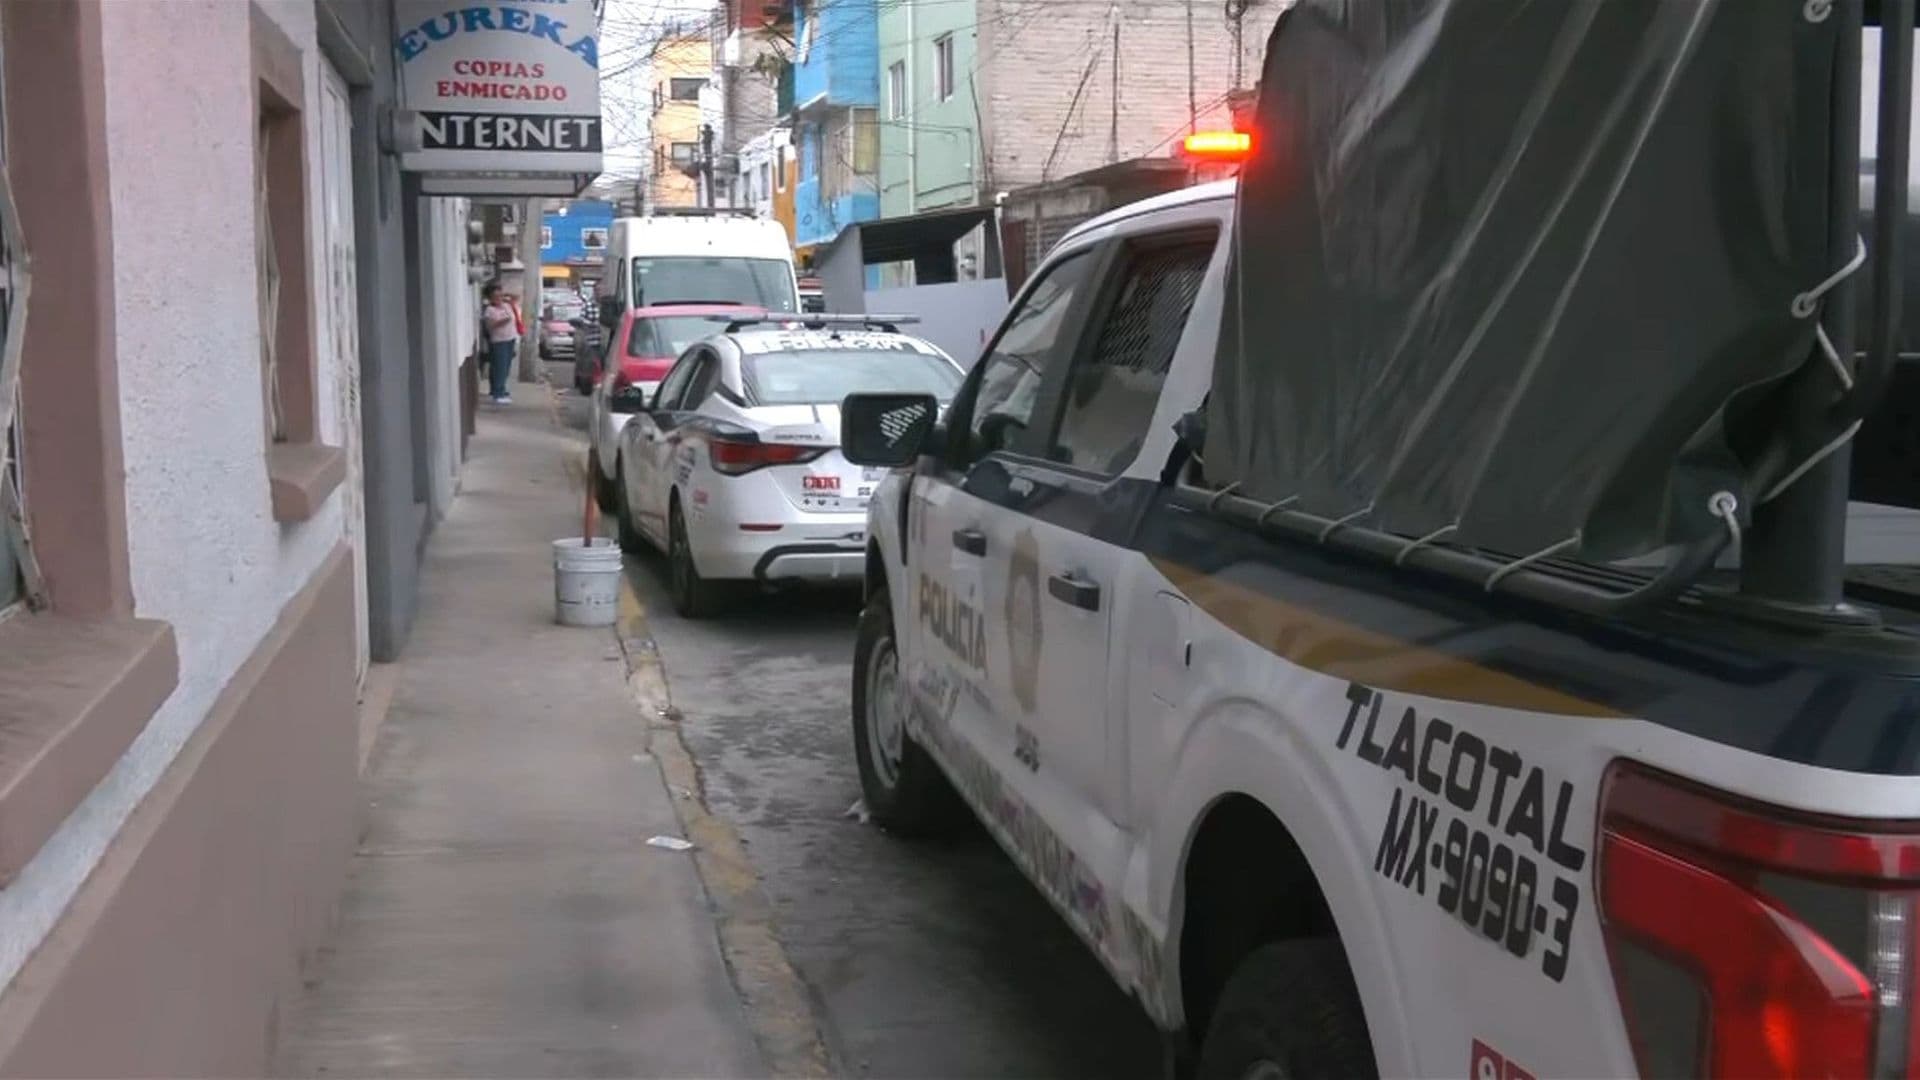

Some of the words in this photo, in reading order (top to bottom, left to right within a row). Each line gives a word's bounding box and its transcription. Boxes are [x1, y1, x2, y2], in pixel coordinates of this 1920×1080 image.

[398, 7, 599, 69] EUREKA
[437, 81, 568, 101] ENMICADO
[454, 60, 545, 78] COPIAS
[418, 115, 596, 149] NTERNET
[1336, 682, 1585, 872] TLACOTAL
[1375, 787, 1579, 983] MX-9090-3
